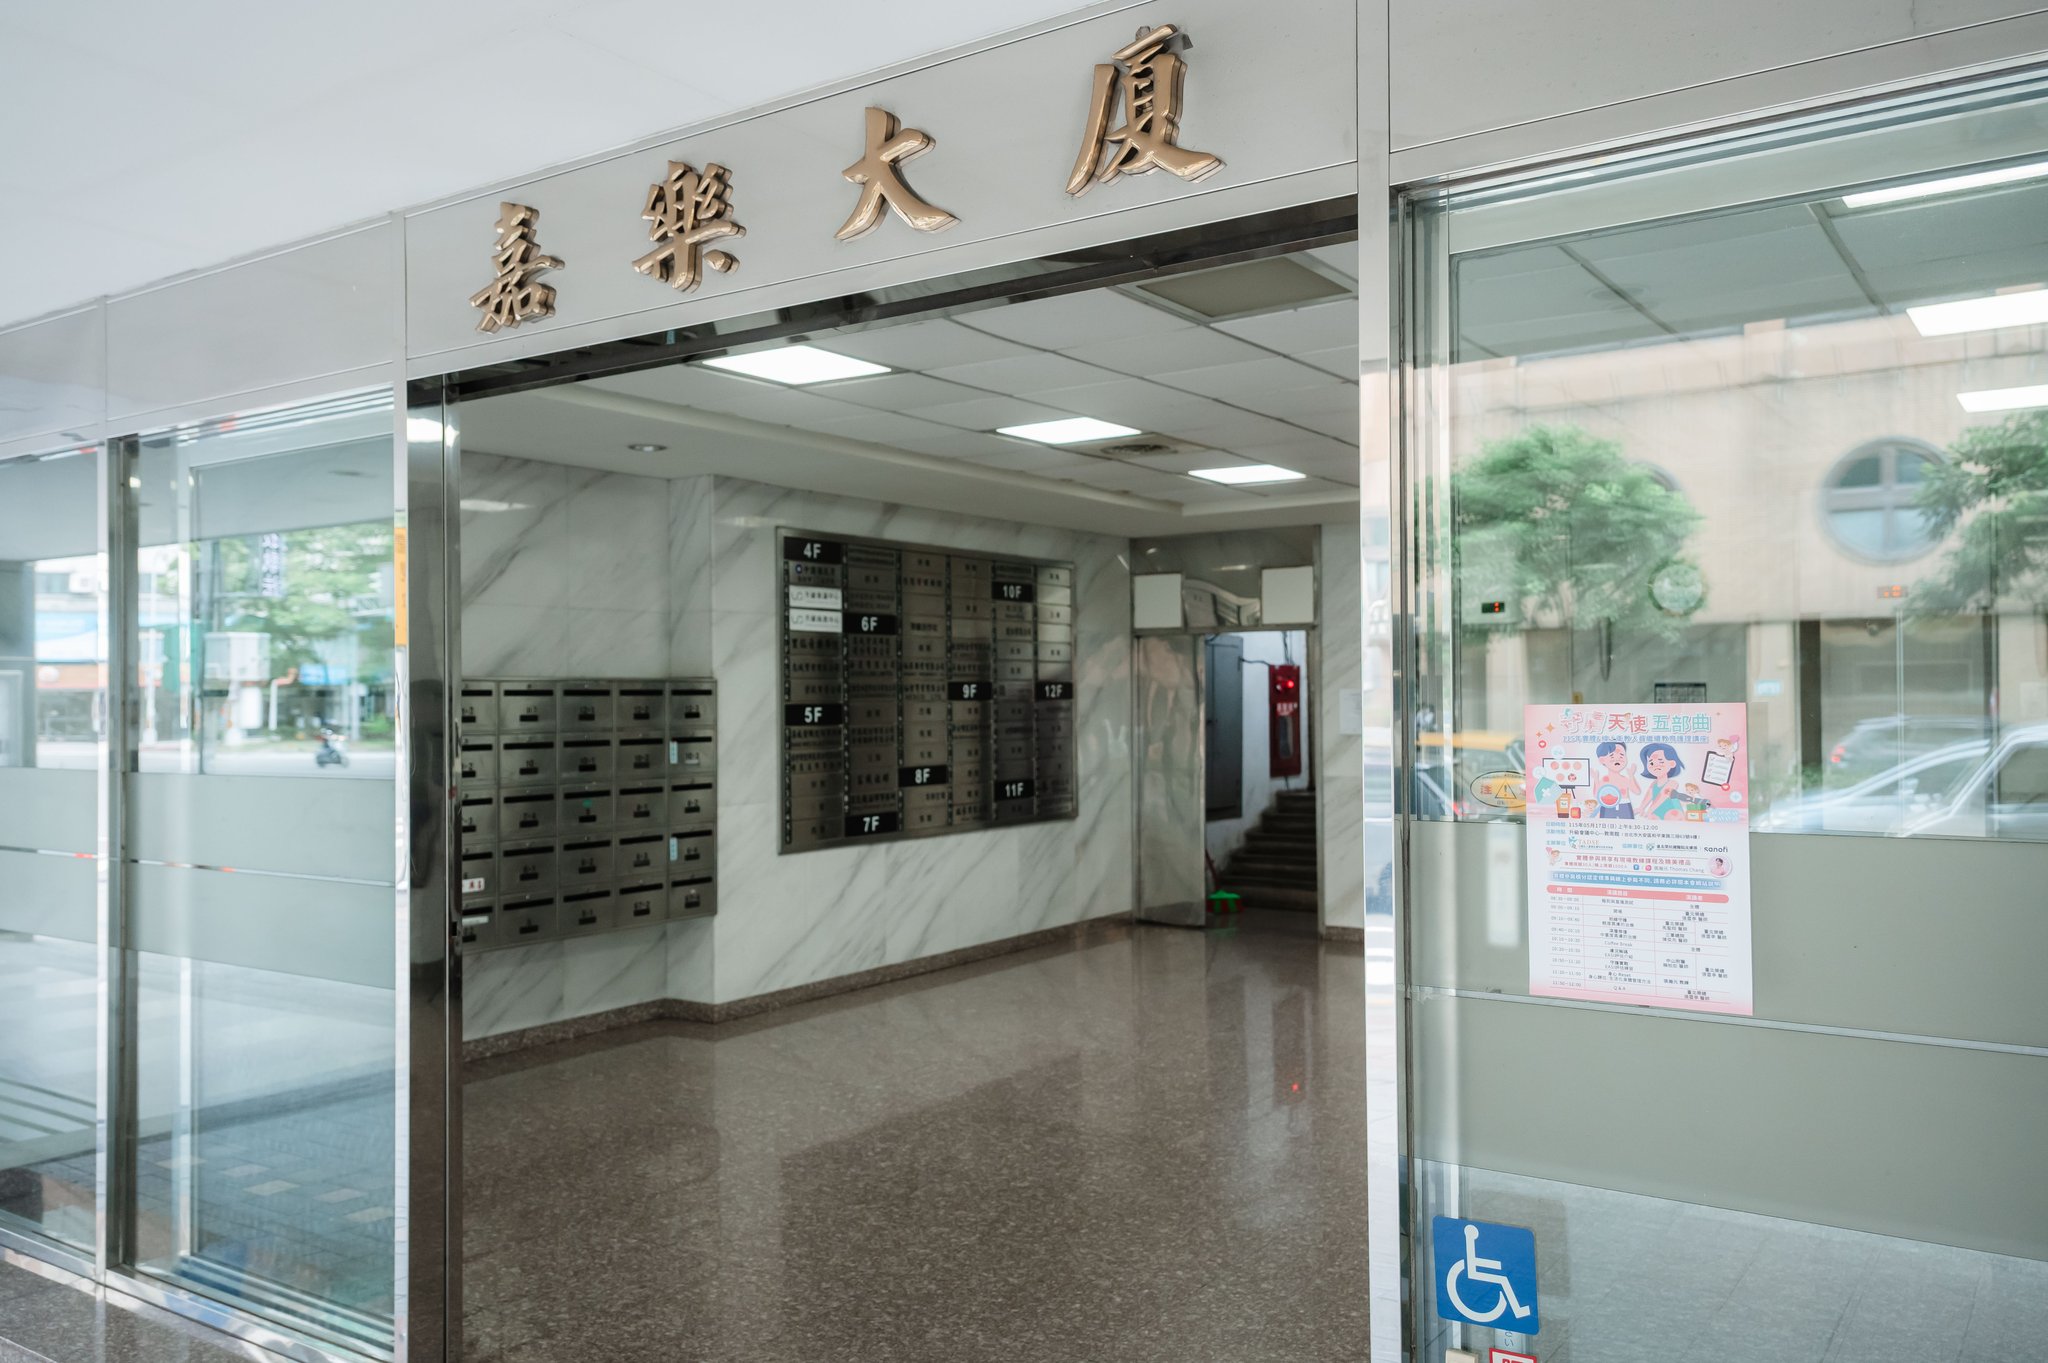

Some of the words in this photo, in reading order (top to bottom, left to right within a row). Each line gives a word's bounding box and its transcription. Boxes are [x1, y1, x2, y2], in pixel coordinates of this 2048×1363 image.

[469, 24, 1227, 334] 嘉樂大廈
[804, 544, 821, 558] 4F
[1003, 585, 1022, 598] 10F
[862, 617, 877, 632] 6F
[963, 684, 977, 698] 9F
[1045, 684, 1062, 698] 12F
[805, 707, 822, 723] 5F
[915, 769, 930, 783] 8F
[1005, 783, 1024, 797] 11F
[863, 816, 879, 832] 7F
